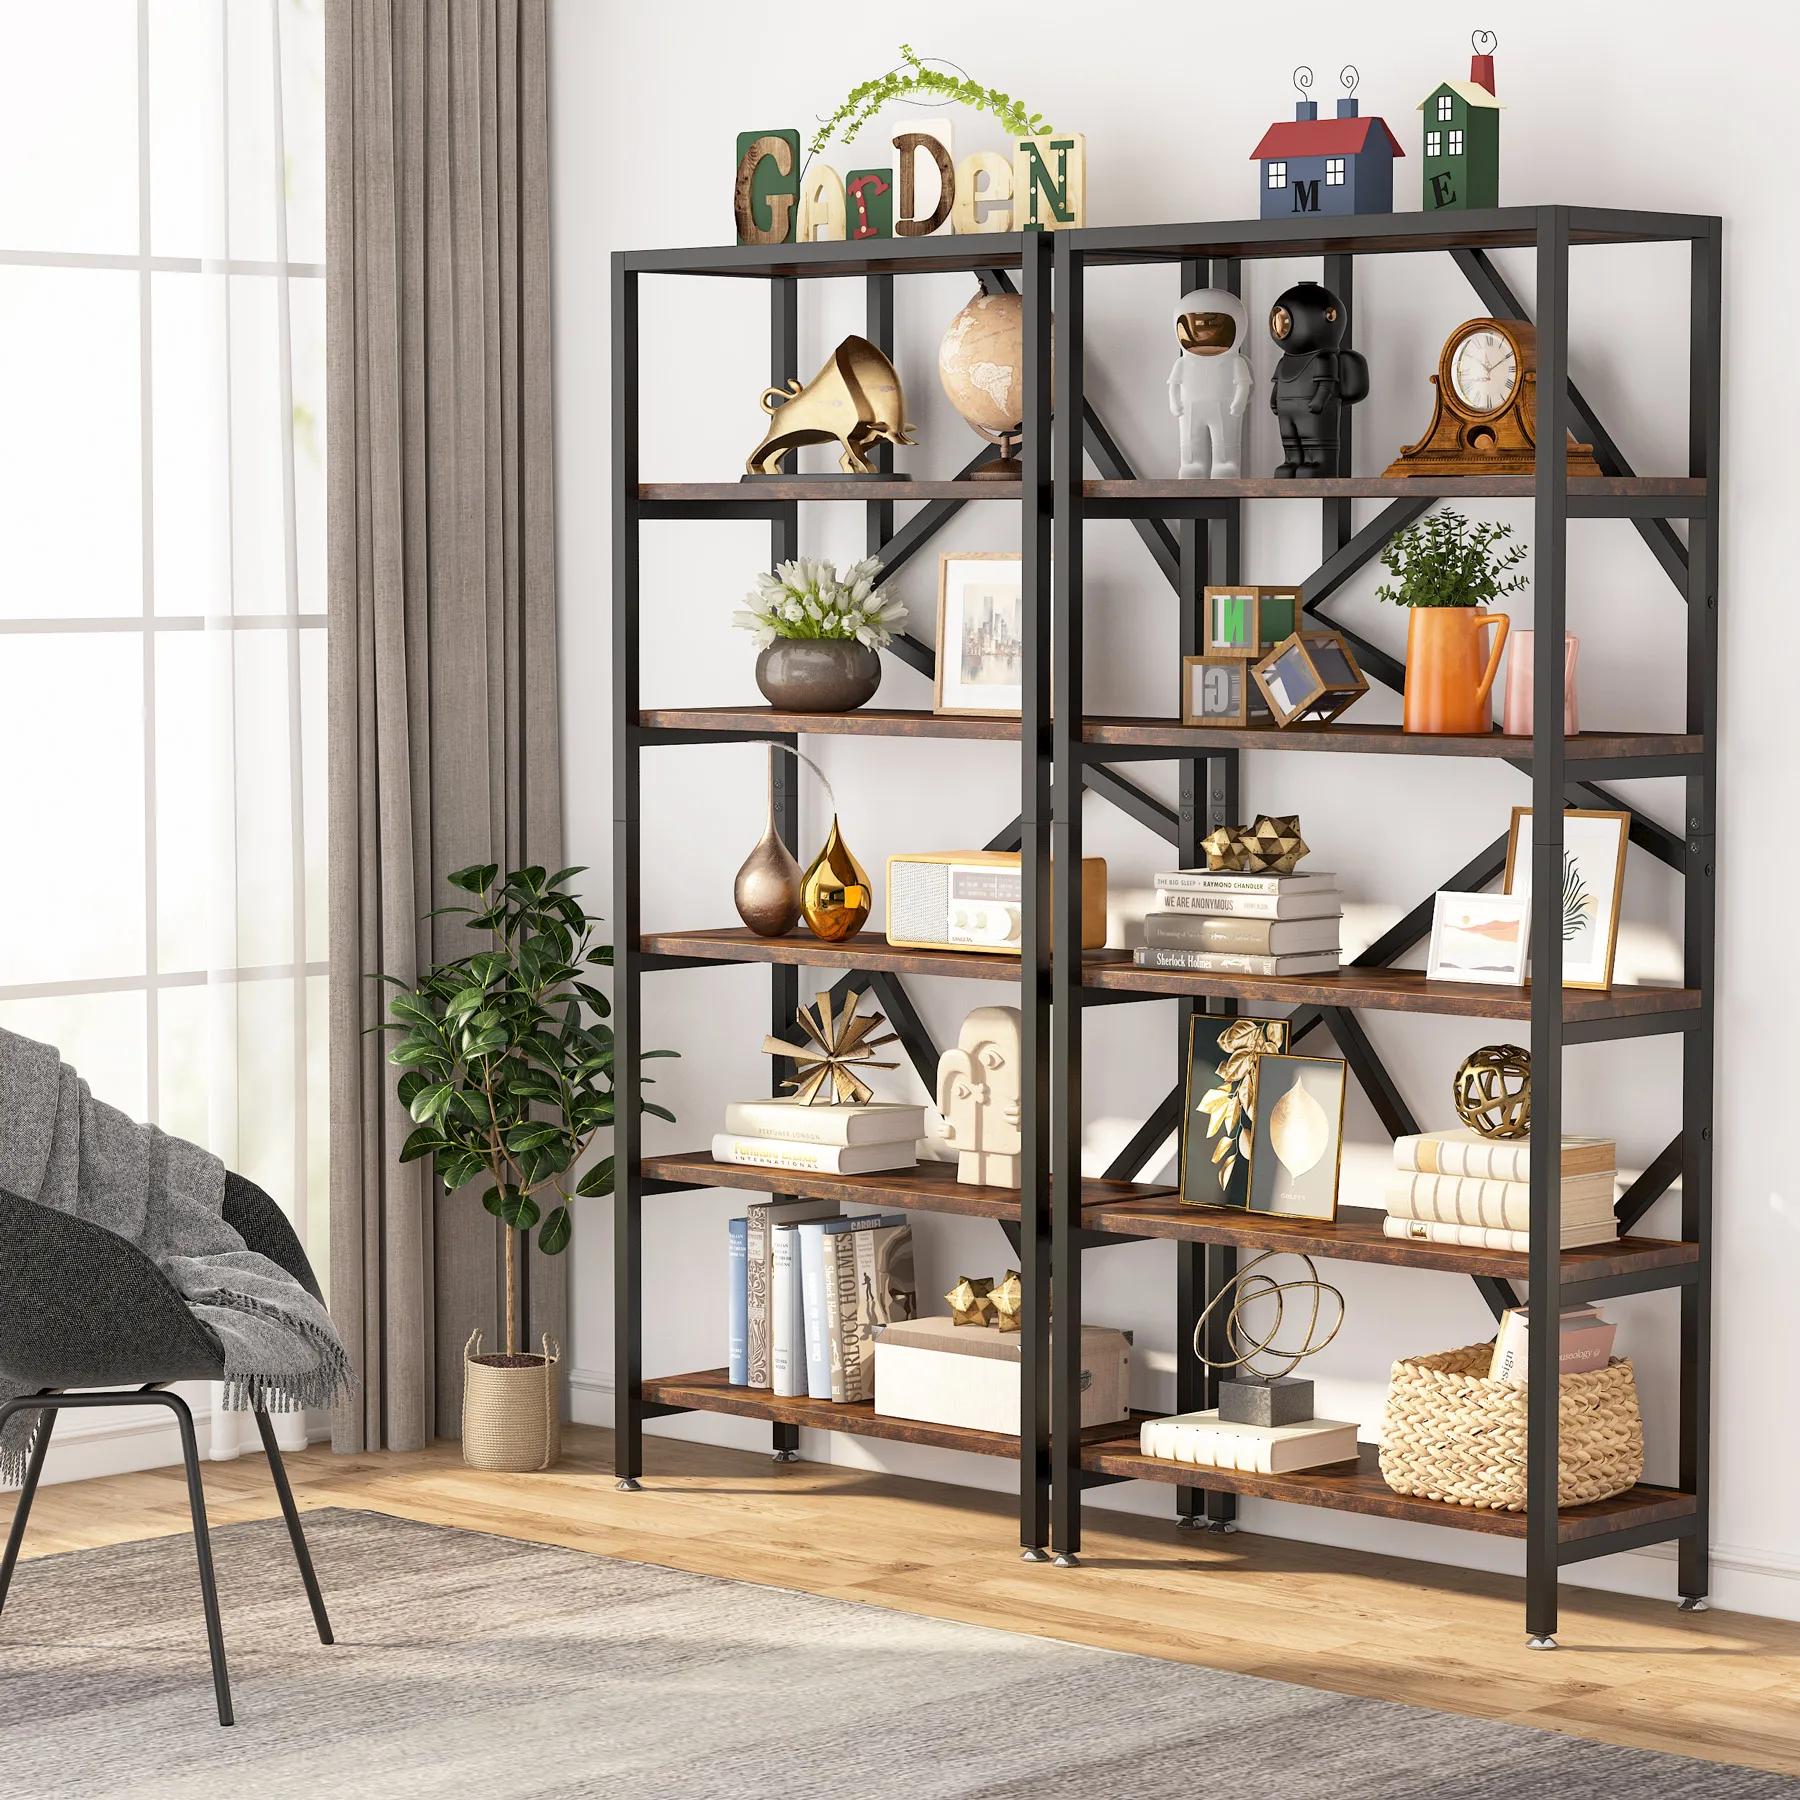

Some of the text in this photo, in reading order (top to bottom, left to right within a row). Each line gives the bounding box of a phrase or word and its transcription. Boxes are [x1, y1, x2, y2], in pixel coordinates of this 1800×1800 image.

[1291, 171, 1457, 213] M E
[1203, 880, 1232, 889] RAYMOND
[1233, 882, 1264, 890] CHANDLER
[1164, 895, 1175, 908] WE
[1176, 896, 1190, 909] ARE
[1191, 898, 1234, 911] ANONYMOUS
[1156, 952, 1186, 967] Sherlock
[1187, 955, 1213, 969] Holmes
[735, 1155, 819, 1169] INTERNATIONAL
[825, 1265, 837, 1329] Sherlock Holmes
[836, 1232, 863, 1402] SHERLOCK HOLMES
